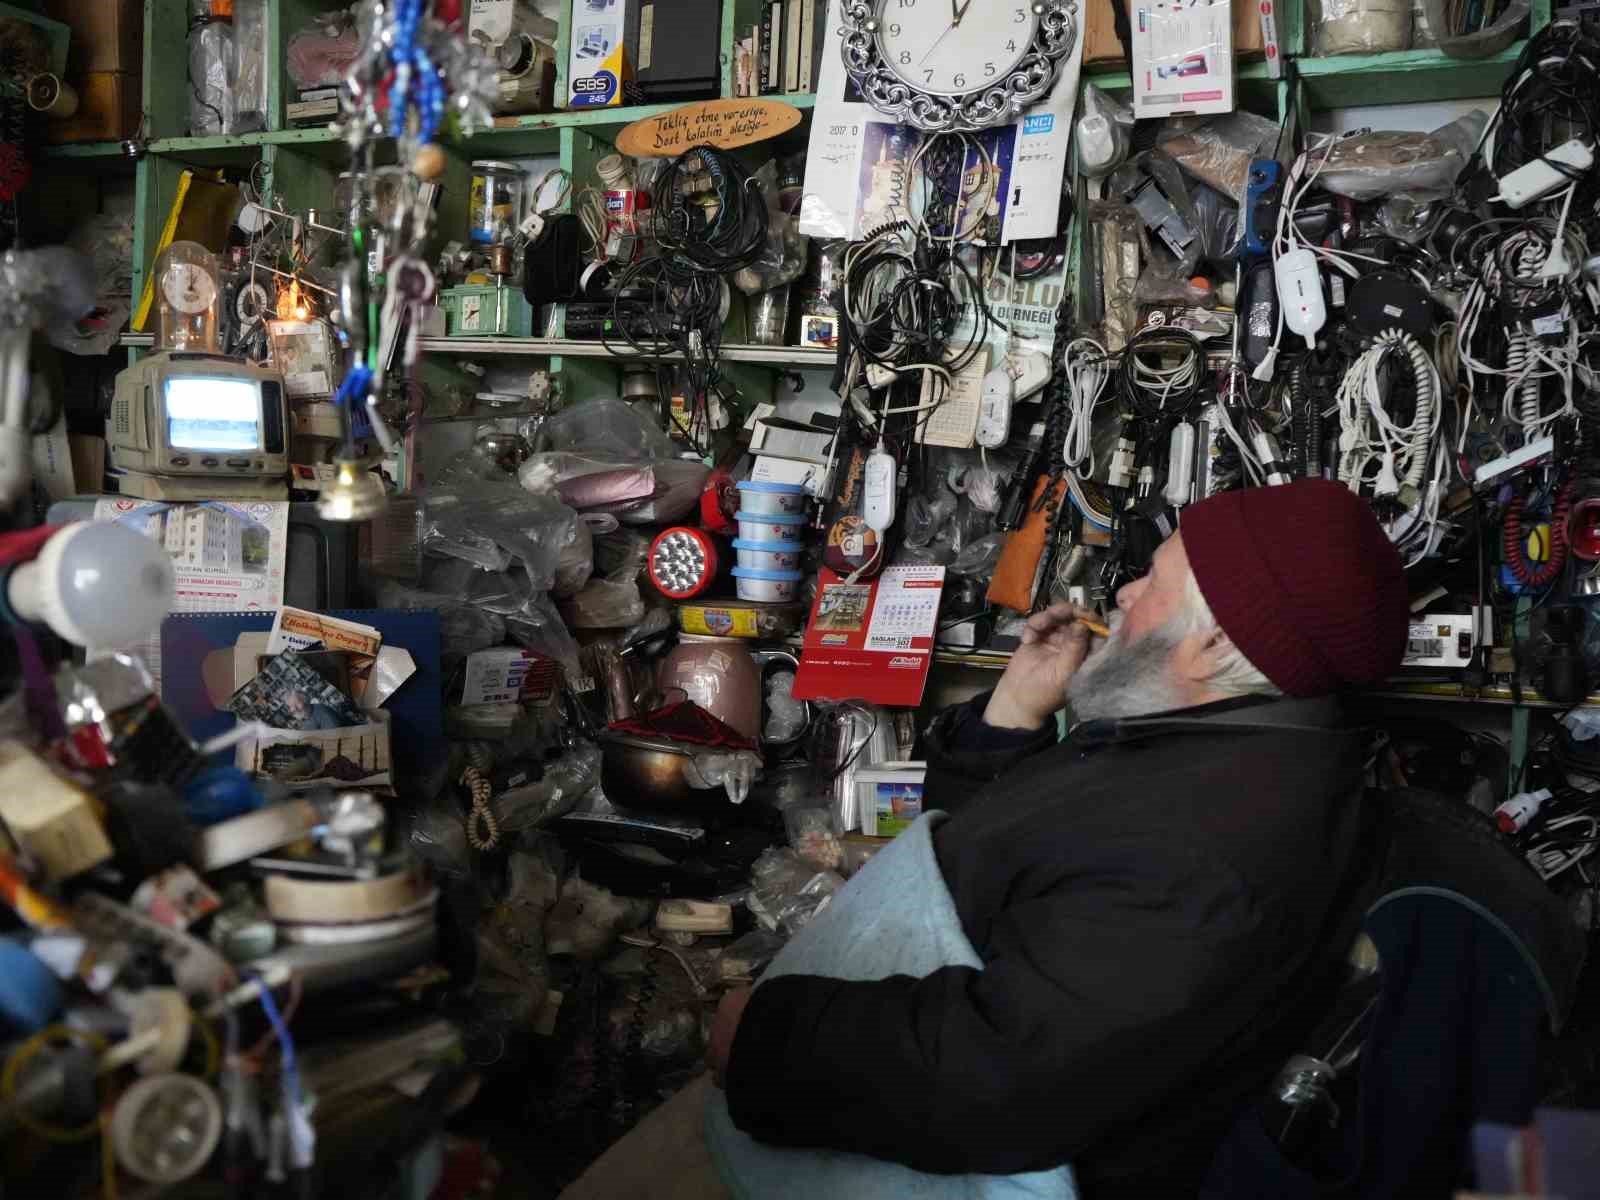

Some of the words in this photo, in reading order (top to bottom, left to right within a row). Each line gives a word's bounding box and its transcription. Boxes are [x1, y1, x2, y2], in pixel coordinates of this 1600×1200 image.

[1014, 9, 1026, 23] 3
[889, 23, 901, 38] 9
[1006, 39, 1017, 53] 4
[899, 51, 912, 65] 8
[922, 69, 935, 83] 7
[984, 62, 996, 77] 5
[576, 79, 607, 92] SBS
[953, 72, 966, 88] 6
